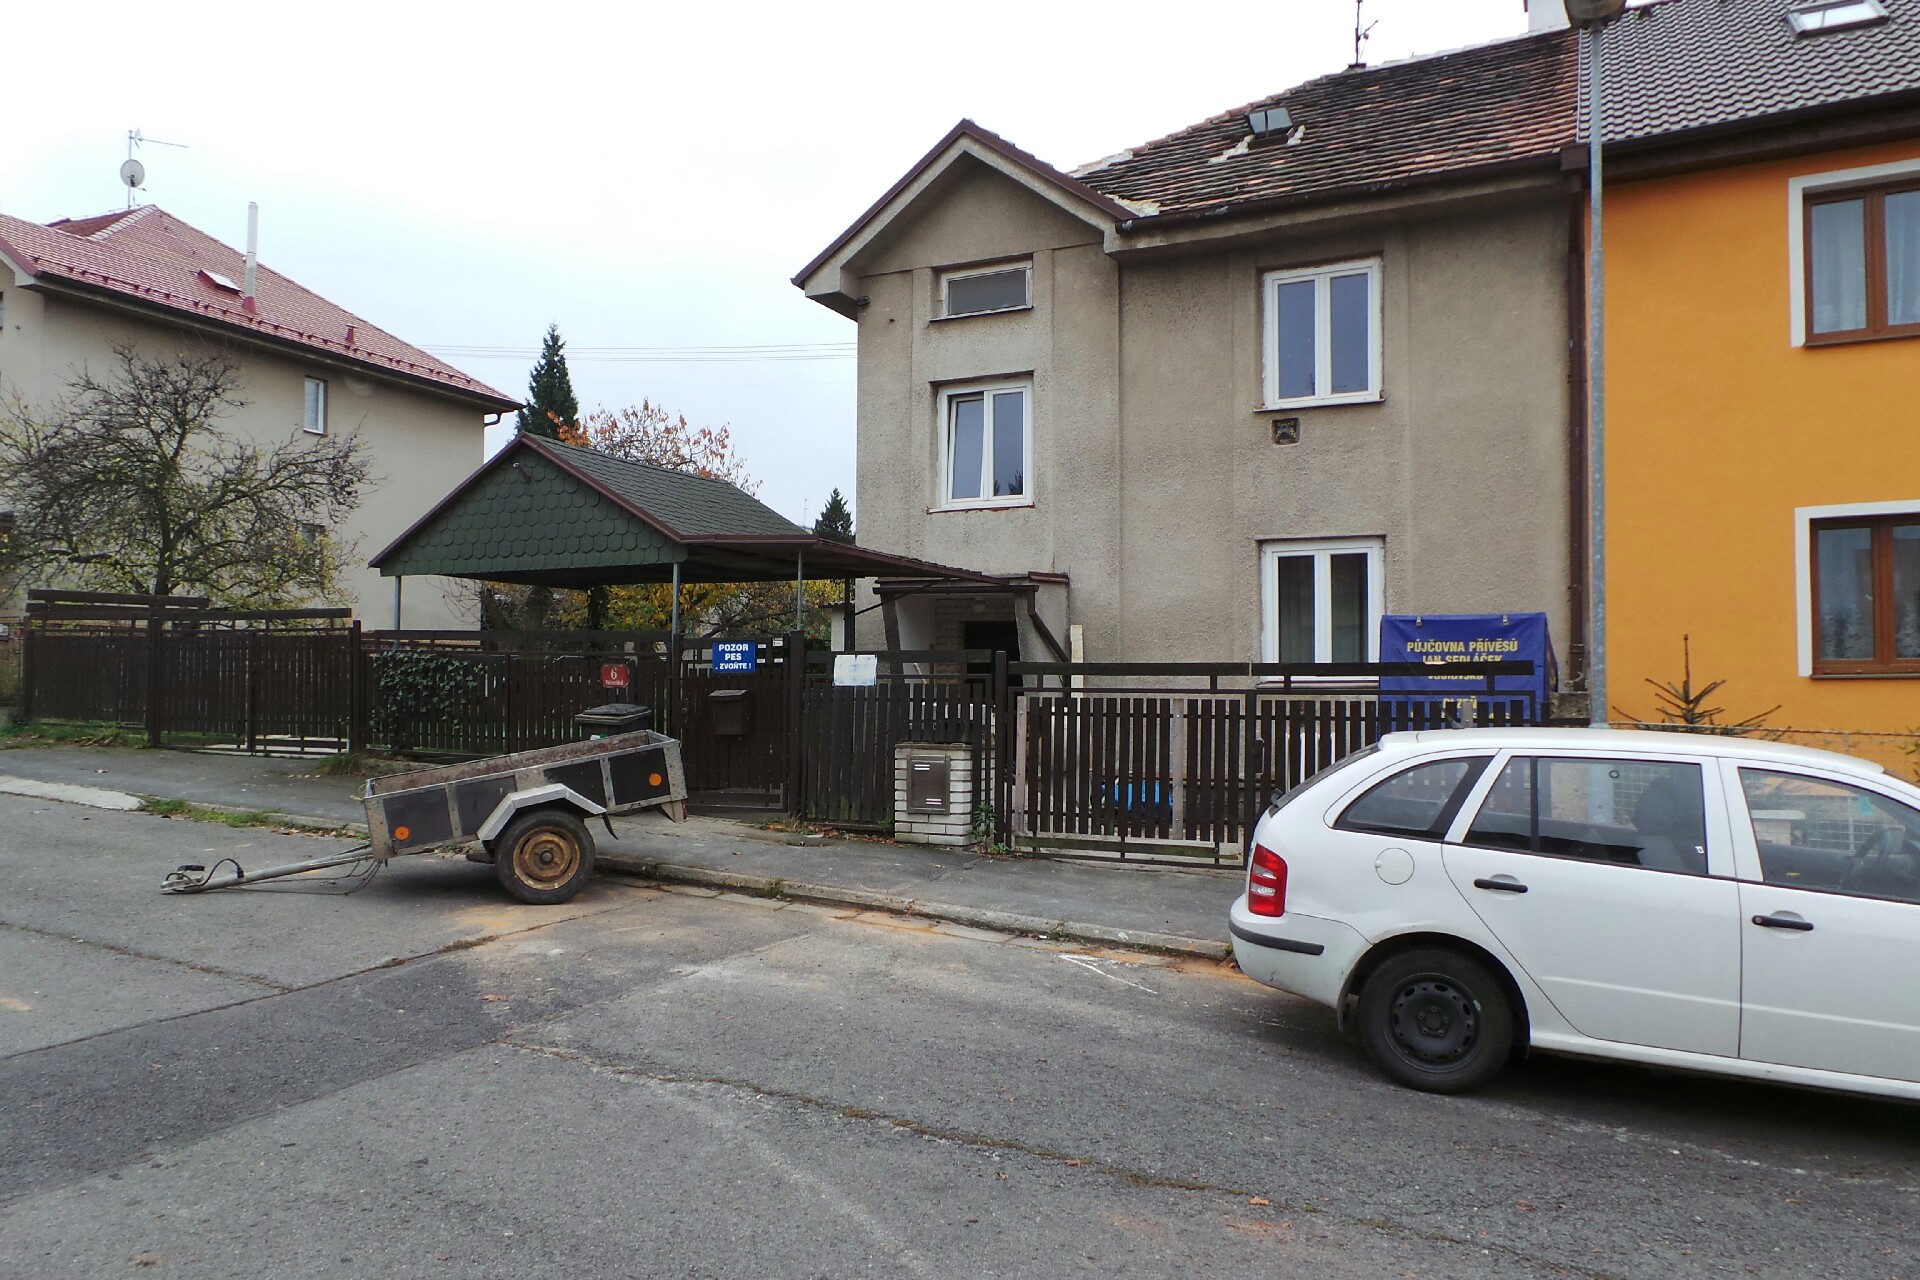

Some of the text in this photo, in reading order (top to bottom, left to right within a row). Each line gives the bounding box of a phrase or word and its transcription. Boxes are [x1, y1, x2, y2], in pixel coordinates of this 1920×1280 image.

[718, 643, 748, 651] POZOR
[1407, 638, 1518, 652] PŮJČOVNA PŘÍVĚSŮ
[610, 667, 617, 680] 6
